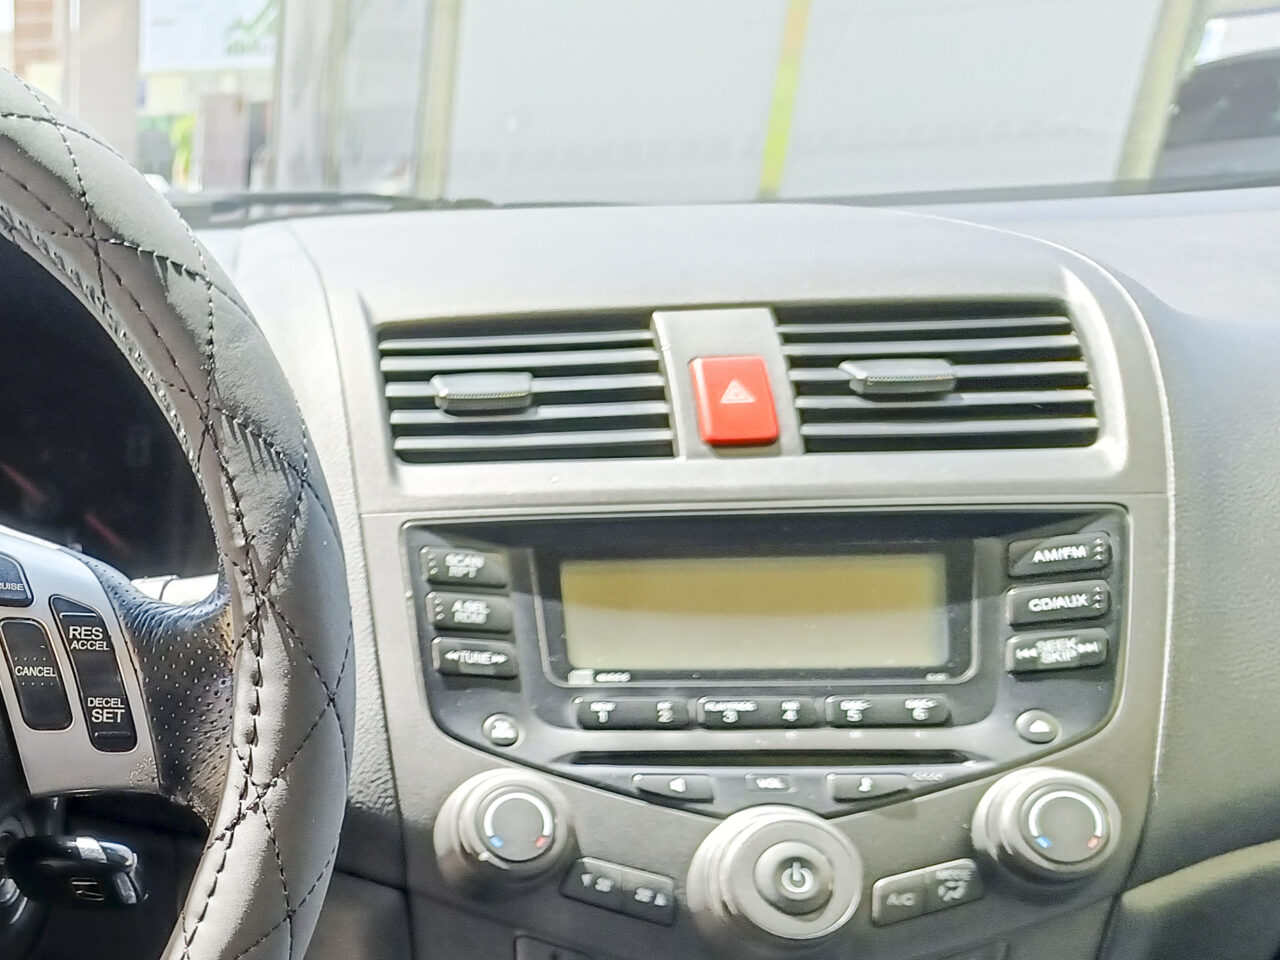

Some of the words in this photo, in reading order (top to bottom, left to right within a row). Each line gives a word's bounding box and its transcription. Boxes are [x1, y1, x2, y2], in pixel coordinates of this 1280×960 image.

[1032, 545, 1087, 562] AM/FM
[1028, 593, 1088, 612] CD/AUX
[70, 626, 103, 640] RES
[70, 640, 110, 651] ACCEL
[1036, 638, 1077, 652] SEEK
[1041, 649, 1077, 664] SKIP
[15, 666, 57, 677] CANCEL
[87, 697, 125, 708] DECEL
[91, 709, 126, 723] SET
[597, 711, 609, 723] 1
[657, 710, 673, 723] 2
[722, 711, 739, 723] 3
[846, 710, 863, 722] 5
